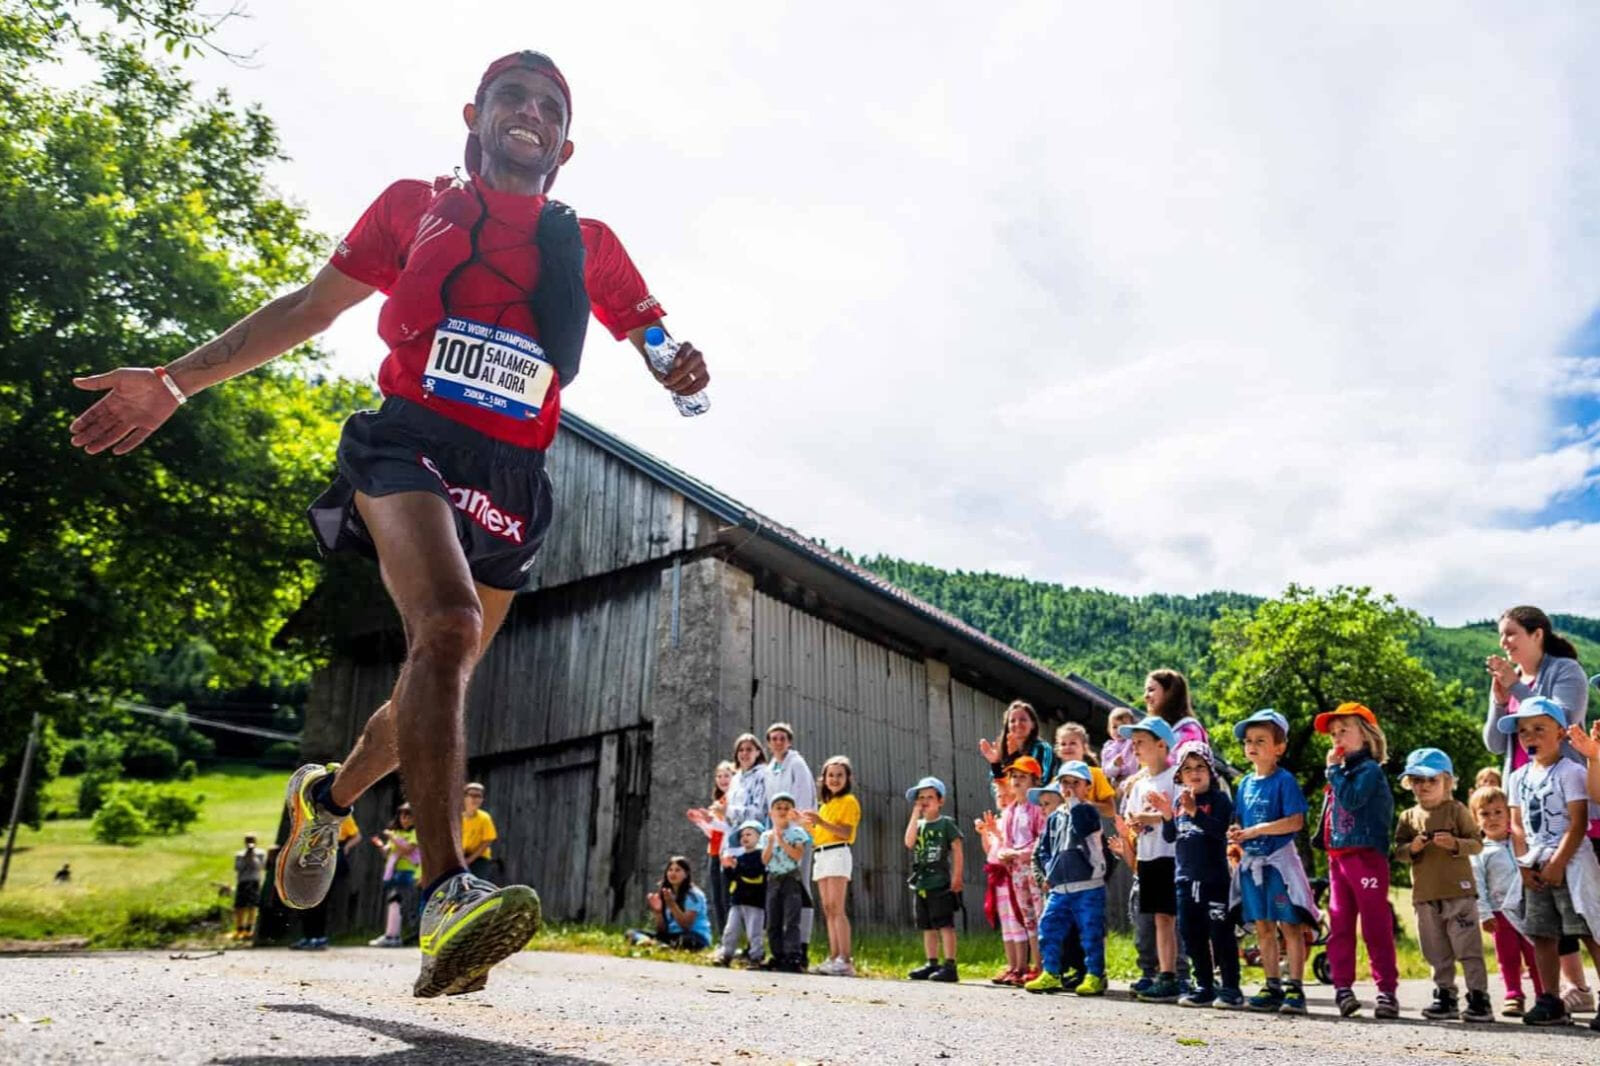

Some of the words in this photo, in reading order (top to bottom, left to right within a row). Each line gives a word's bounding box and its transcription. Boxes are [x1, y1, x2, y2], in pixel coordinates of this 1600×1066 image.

[447, 318, 467, 332] 2022
[434, 336, 486, 380] 100
[484, 347, 540, 379] SALAMEH
[480, 366, 494, 384] AL
[1360, 876, 1379, 889] 92
